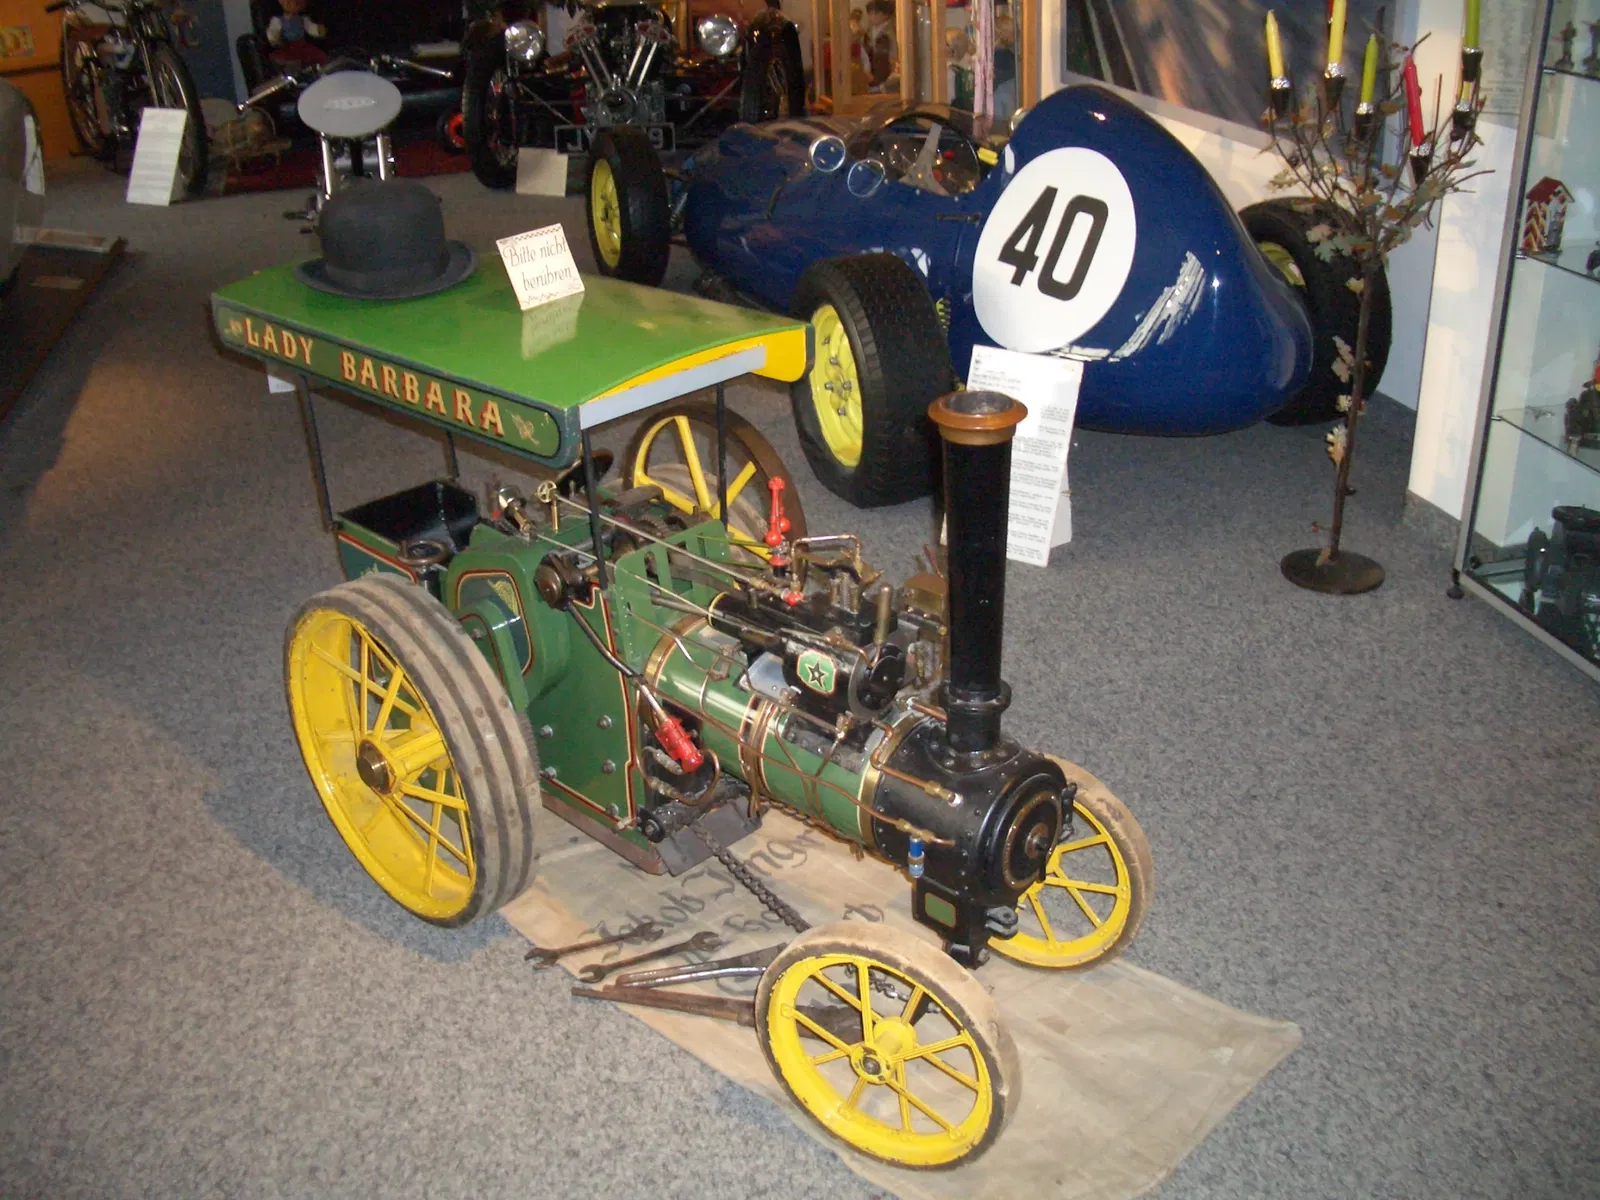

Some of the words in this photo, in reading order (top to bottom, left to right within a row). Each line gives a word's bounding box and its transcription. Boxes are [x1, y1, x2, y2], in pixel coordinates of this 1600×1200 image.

[503, 244, 537, 267] Bitte
[539, 236, 567, 258] nicht
[521, 264, 572, 291] berühren
[997, 185, 1109, 301] 40
[243, 317, 313, 365] LADY
[340, 350, 505, 438] BARBARA
